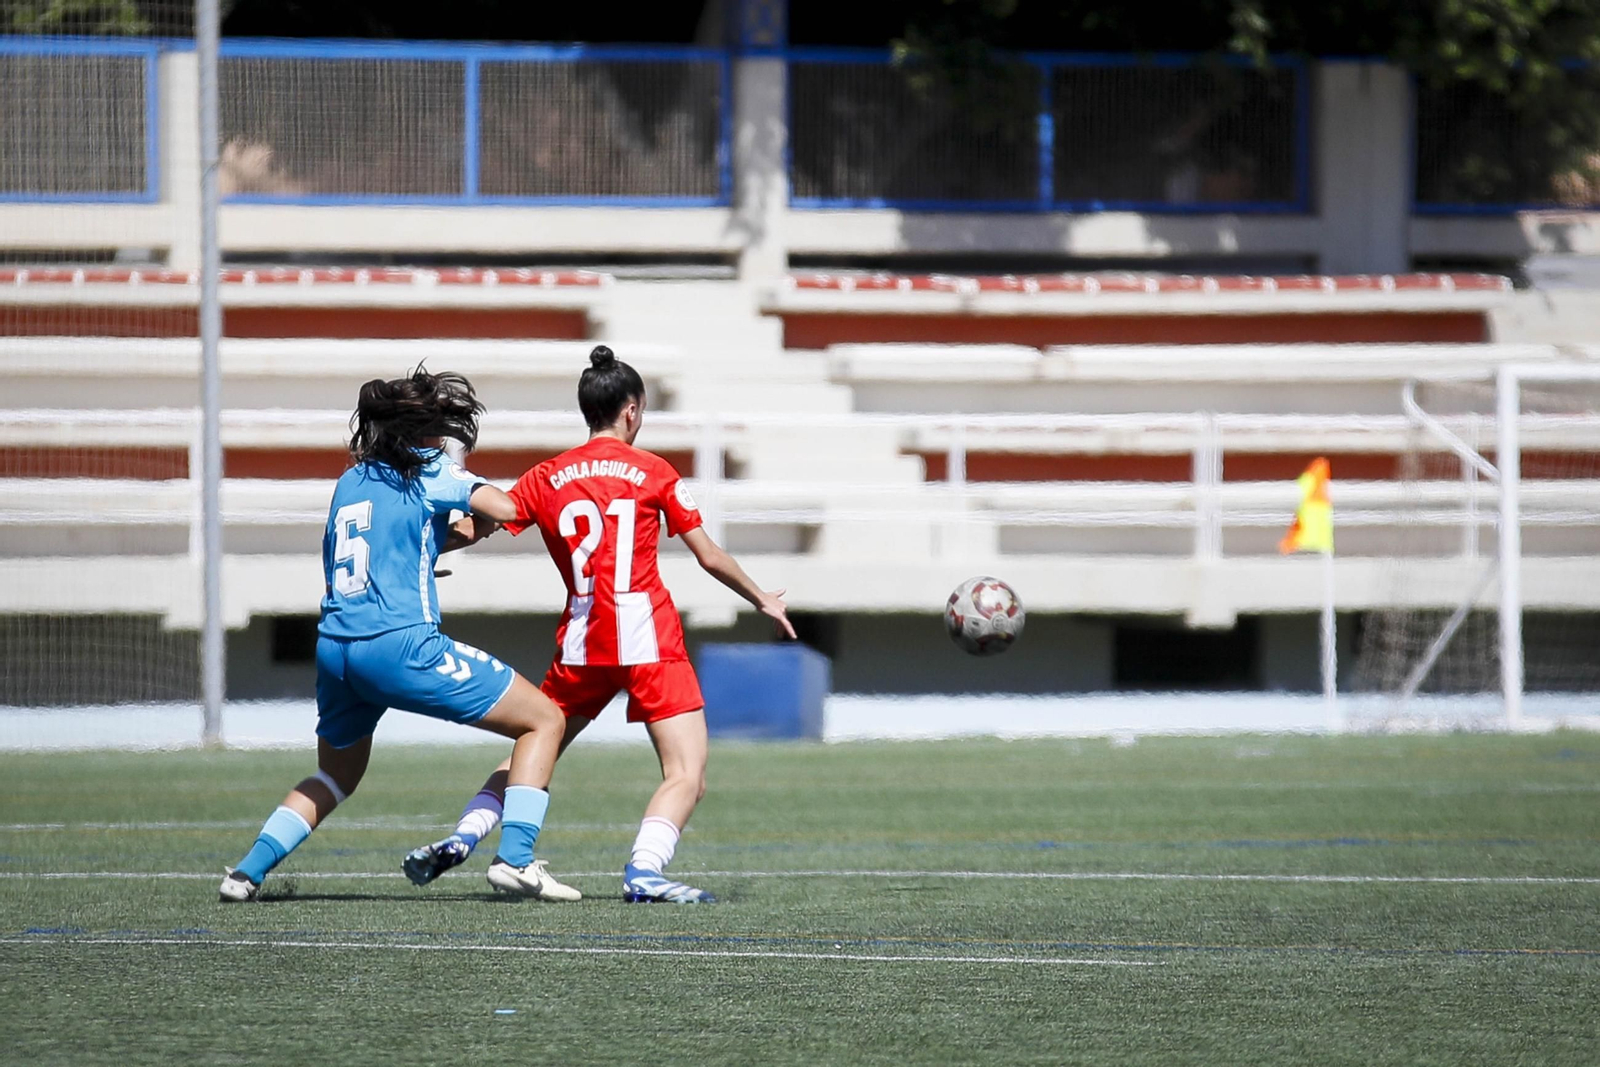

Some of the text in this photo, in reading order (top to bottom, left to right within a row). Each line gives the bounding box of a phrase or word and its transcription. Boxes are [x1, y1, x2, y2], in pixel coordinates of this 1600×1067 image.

[549, 459, 647, 490] CARLA AGUILAR
[334, 499, 373, 598] 5
[558, 498, 636, 596] 21
